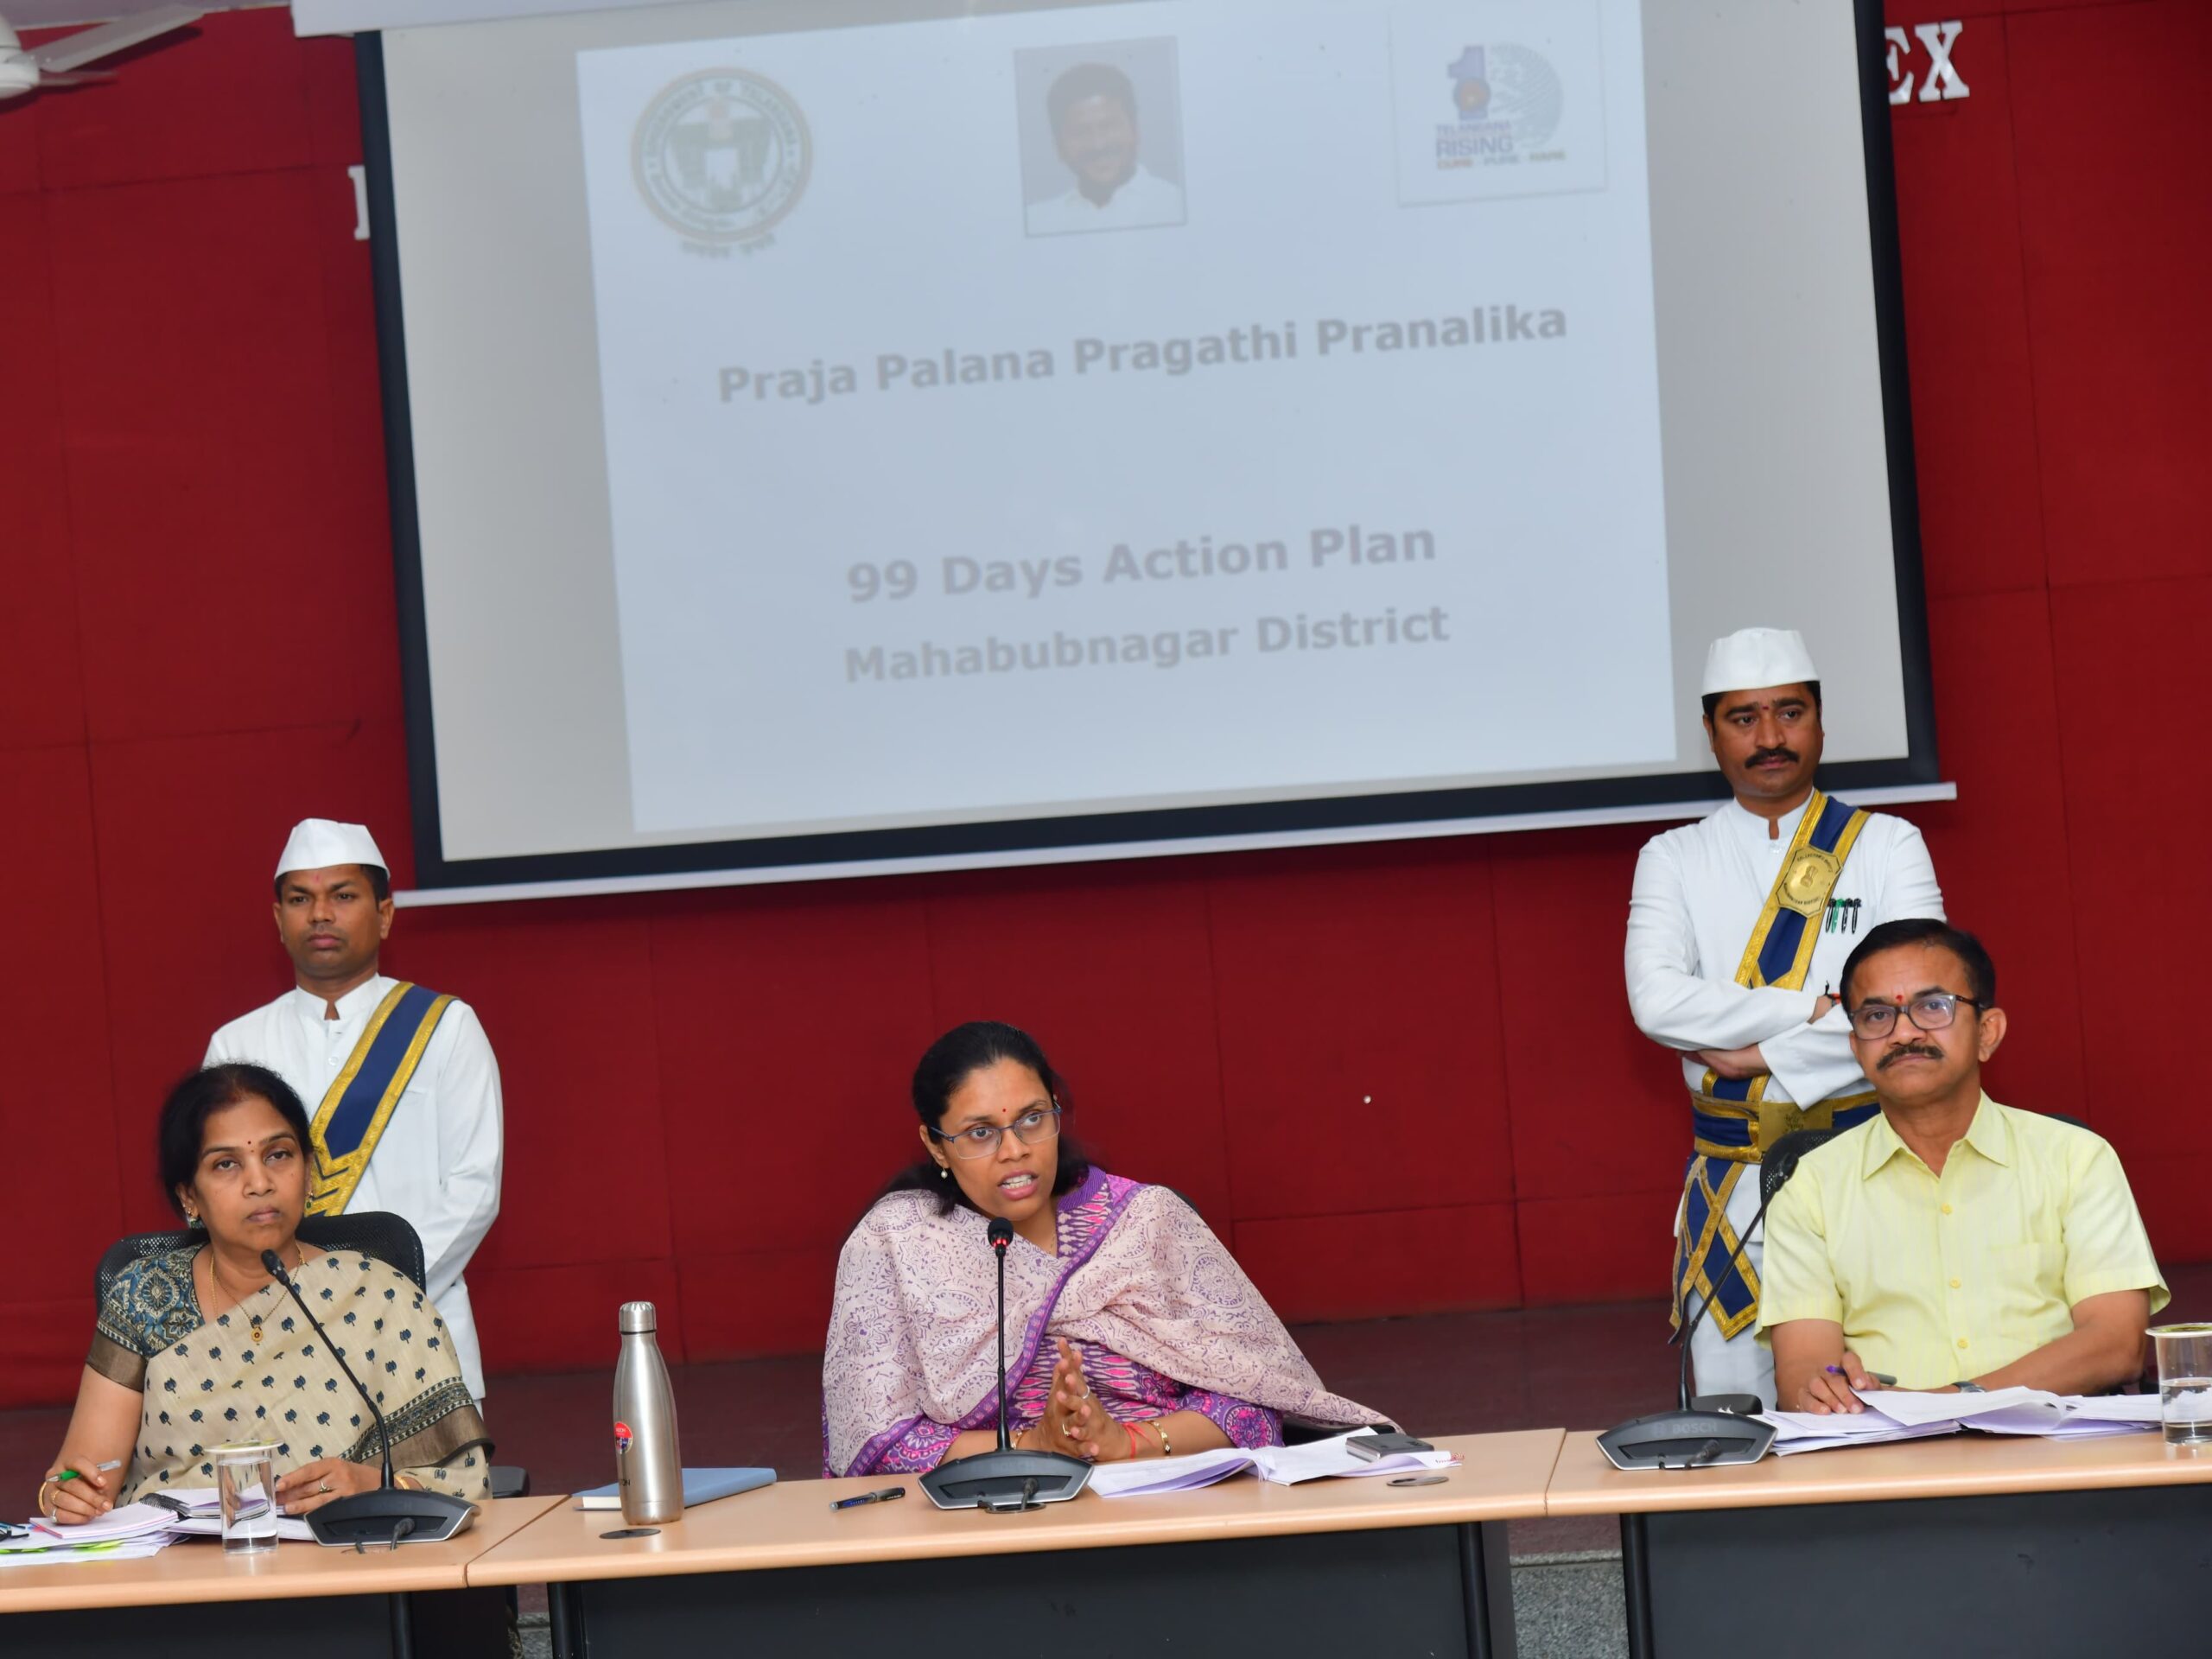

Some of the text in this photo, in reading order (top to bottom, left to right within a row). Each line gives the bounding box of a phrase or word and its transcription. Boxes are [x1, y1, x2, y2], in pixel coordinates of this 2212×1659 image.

[1435, 135, 1514, 158] RISING
[718, 302, 1567, 406] Praja Palana Pragathi Pranalika
[847, 523, 1436, 604] 99 Days Action Plan
[845, 605, 1451, 683] Mahabubnagar District
[1672, 1421, 1718, 1434] BOSCH
